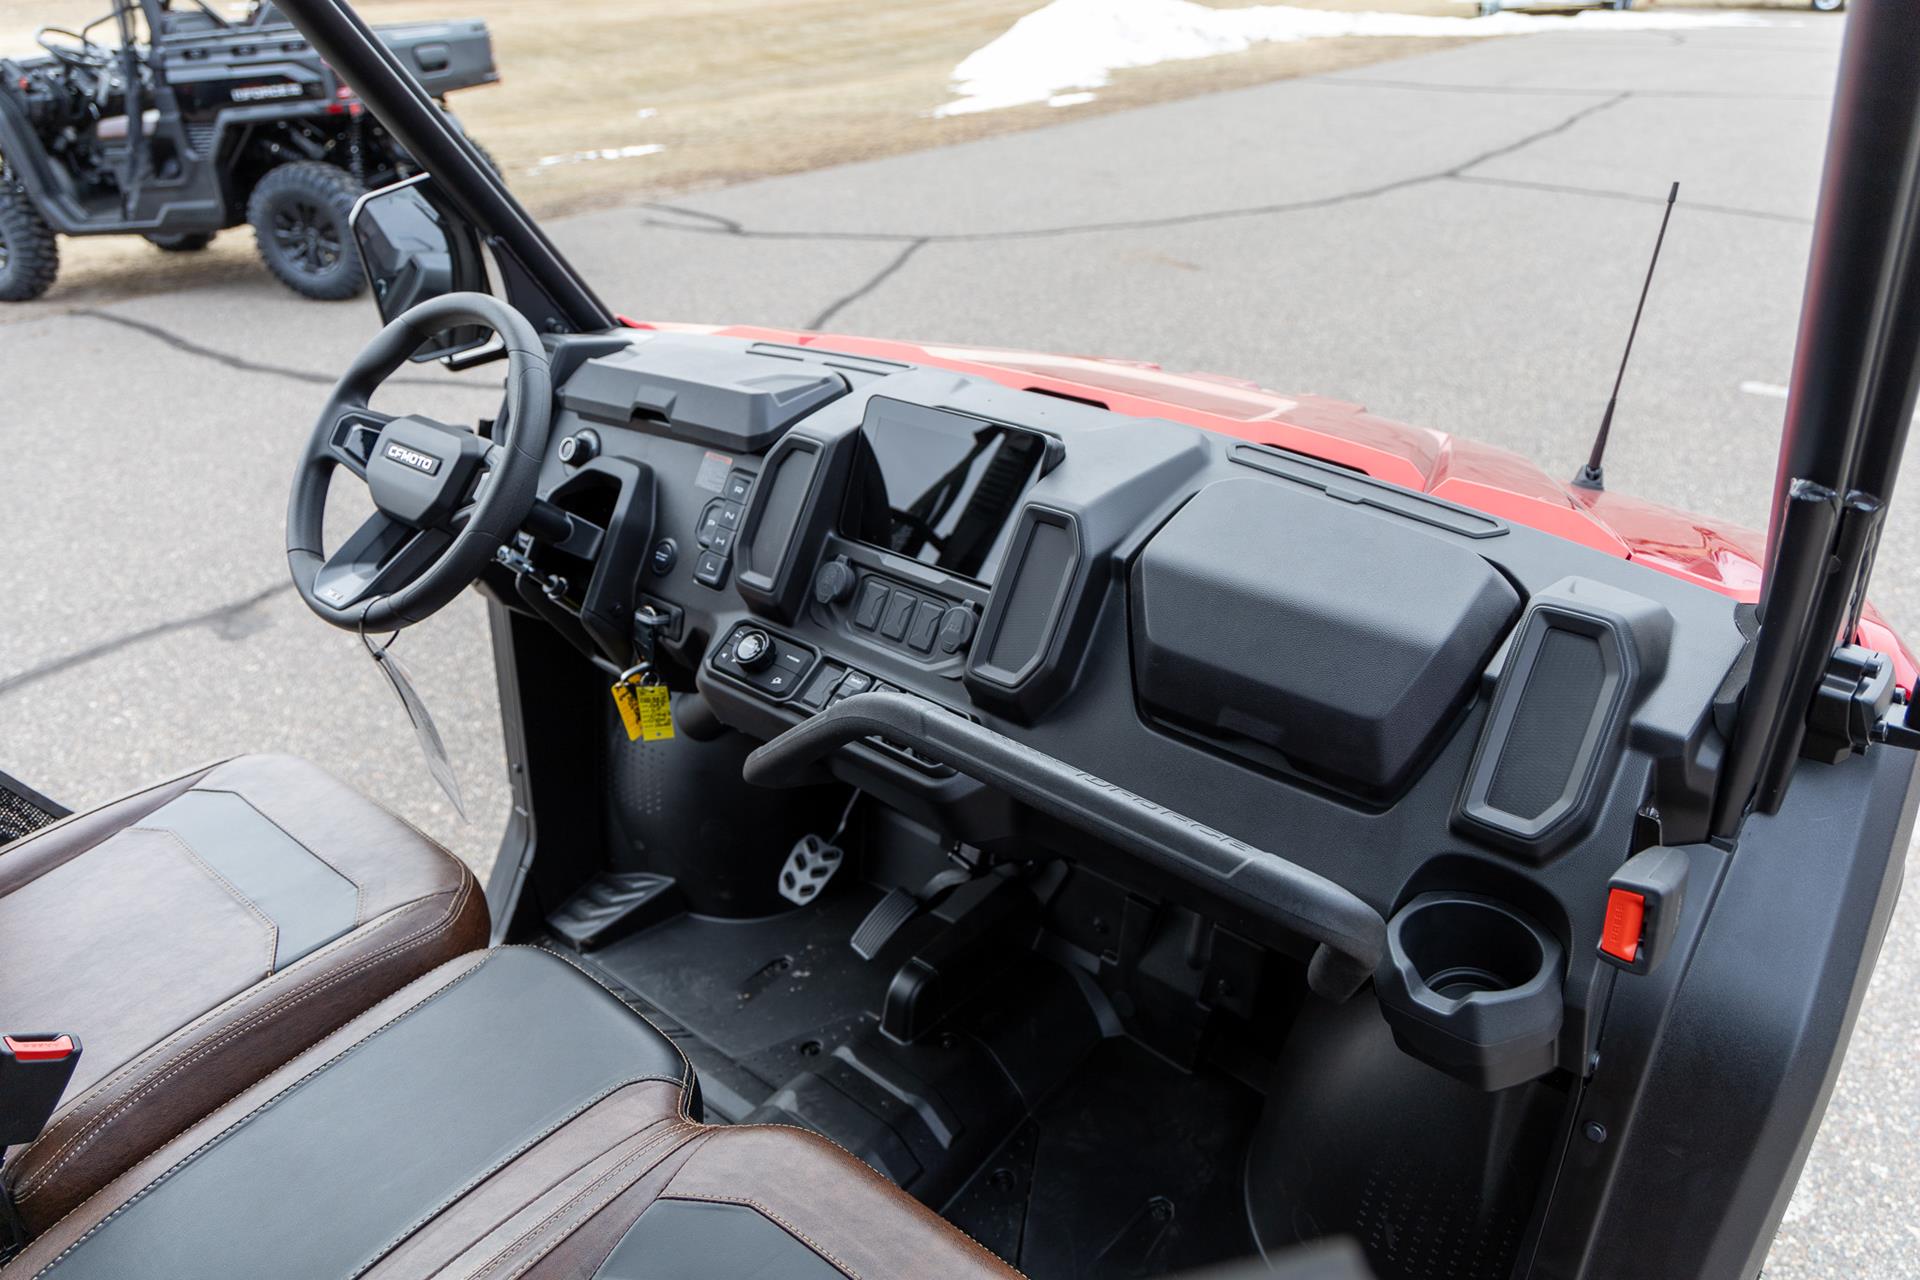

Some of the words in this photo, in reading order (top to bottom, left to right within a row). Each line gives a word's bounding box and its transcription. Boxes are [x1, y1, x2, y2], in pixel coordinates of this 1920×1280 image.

[388, 445, 433, 470] CFMOTO
[734, 486, 744, 494] R
[724, 511, 735, 520] N
[715, 536, 725, 545] H
[705, 562, 715, 571] L
